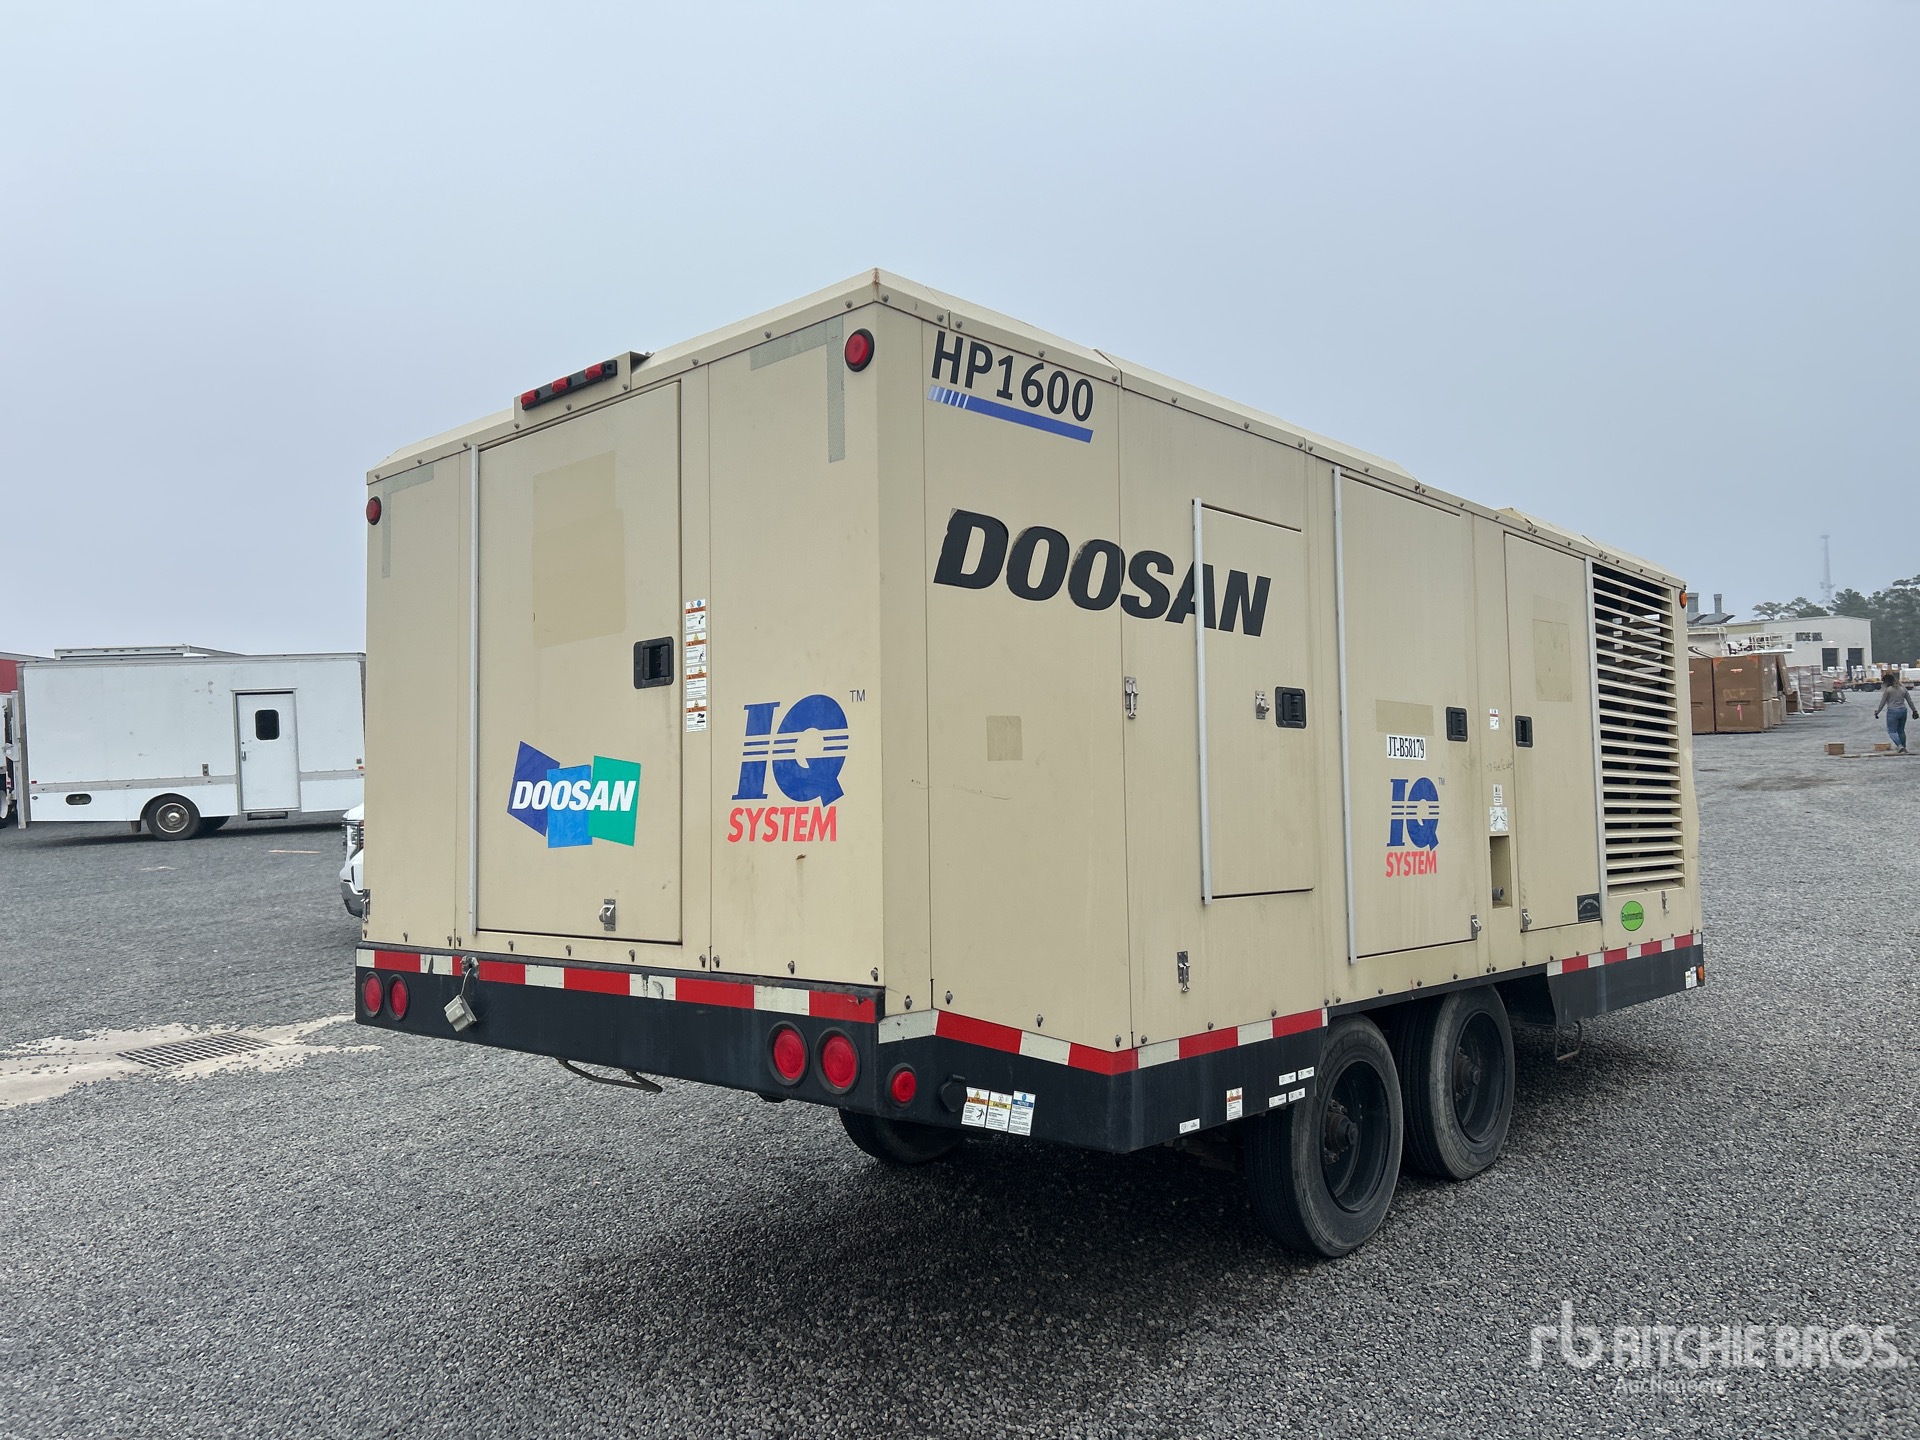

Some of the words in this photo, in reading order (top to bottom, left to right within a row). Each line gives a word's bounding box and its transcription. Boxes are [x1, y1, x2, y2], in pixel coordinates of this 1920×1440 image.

[931, 330, 1094, 422] HP1600
[933, 507, 1272, 638] DOOSAN
[731, 693, 850, 808] IQ
[849, 689, 866, 703] TM
[1387, 736, 1425, 759] JT-B58179
[511, 779, 637, 812] DOOSAN
[726, 805, 837, 843] SYSTEM
[1386, 776, 1440, 852] IQ
[1385, 850, 1438, 878] SYSTEM
